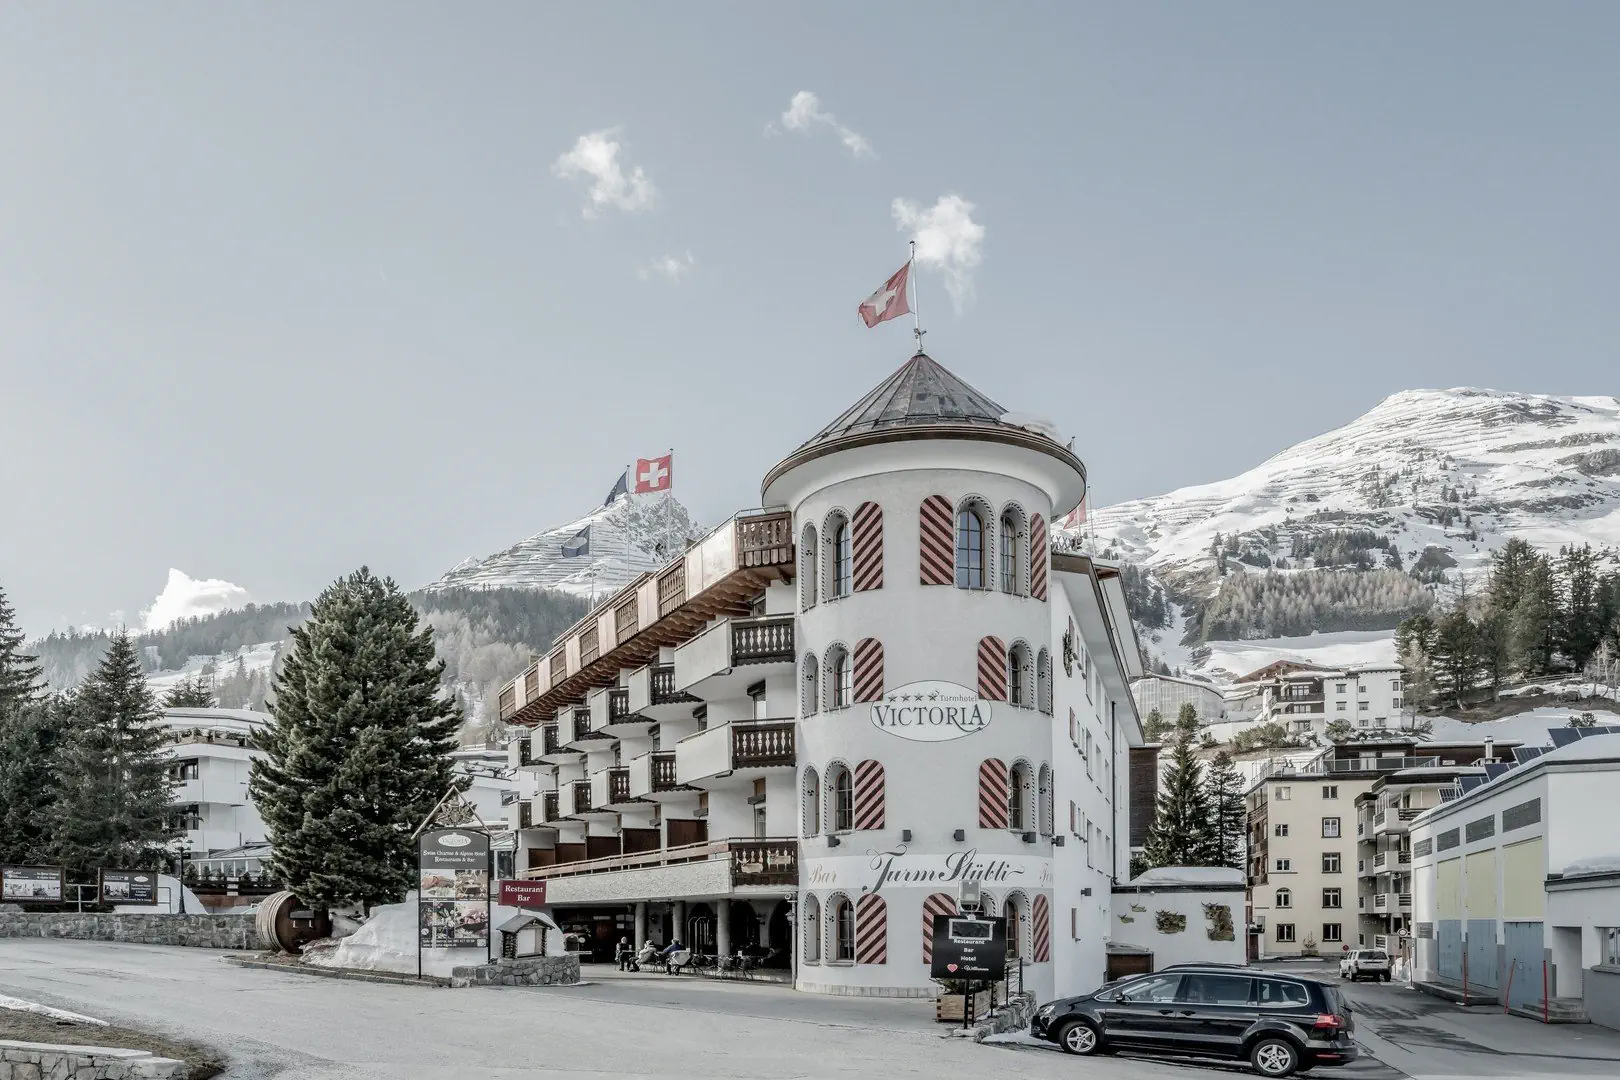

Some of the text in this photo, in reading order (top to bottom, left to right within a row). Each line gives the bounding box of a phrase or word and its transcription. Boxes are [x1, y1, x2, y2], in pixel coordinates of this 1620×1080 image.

[940, 694, 978, 703] Turmhotel
[874, 704, 986, 733] VICTORIA
[809, 864, 838, 885] Bar
[505, 884, 544, 893] Restaurant
[517, 894, 531, 902] Bar
